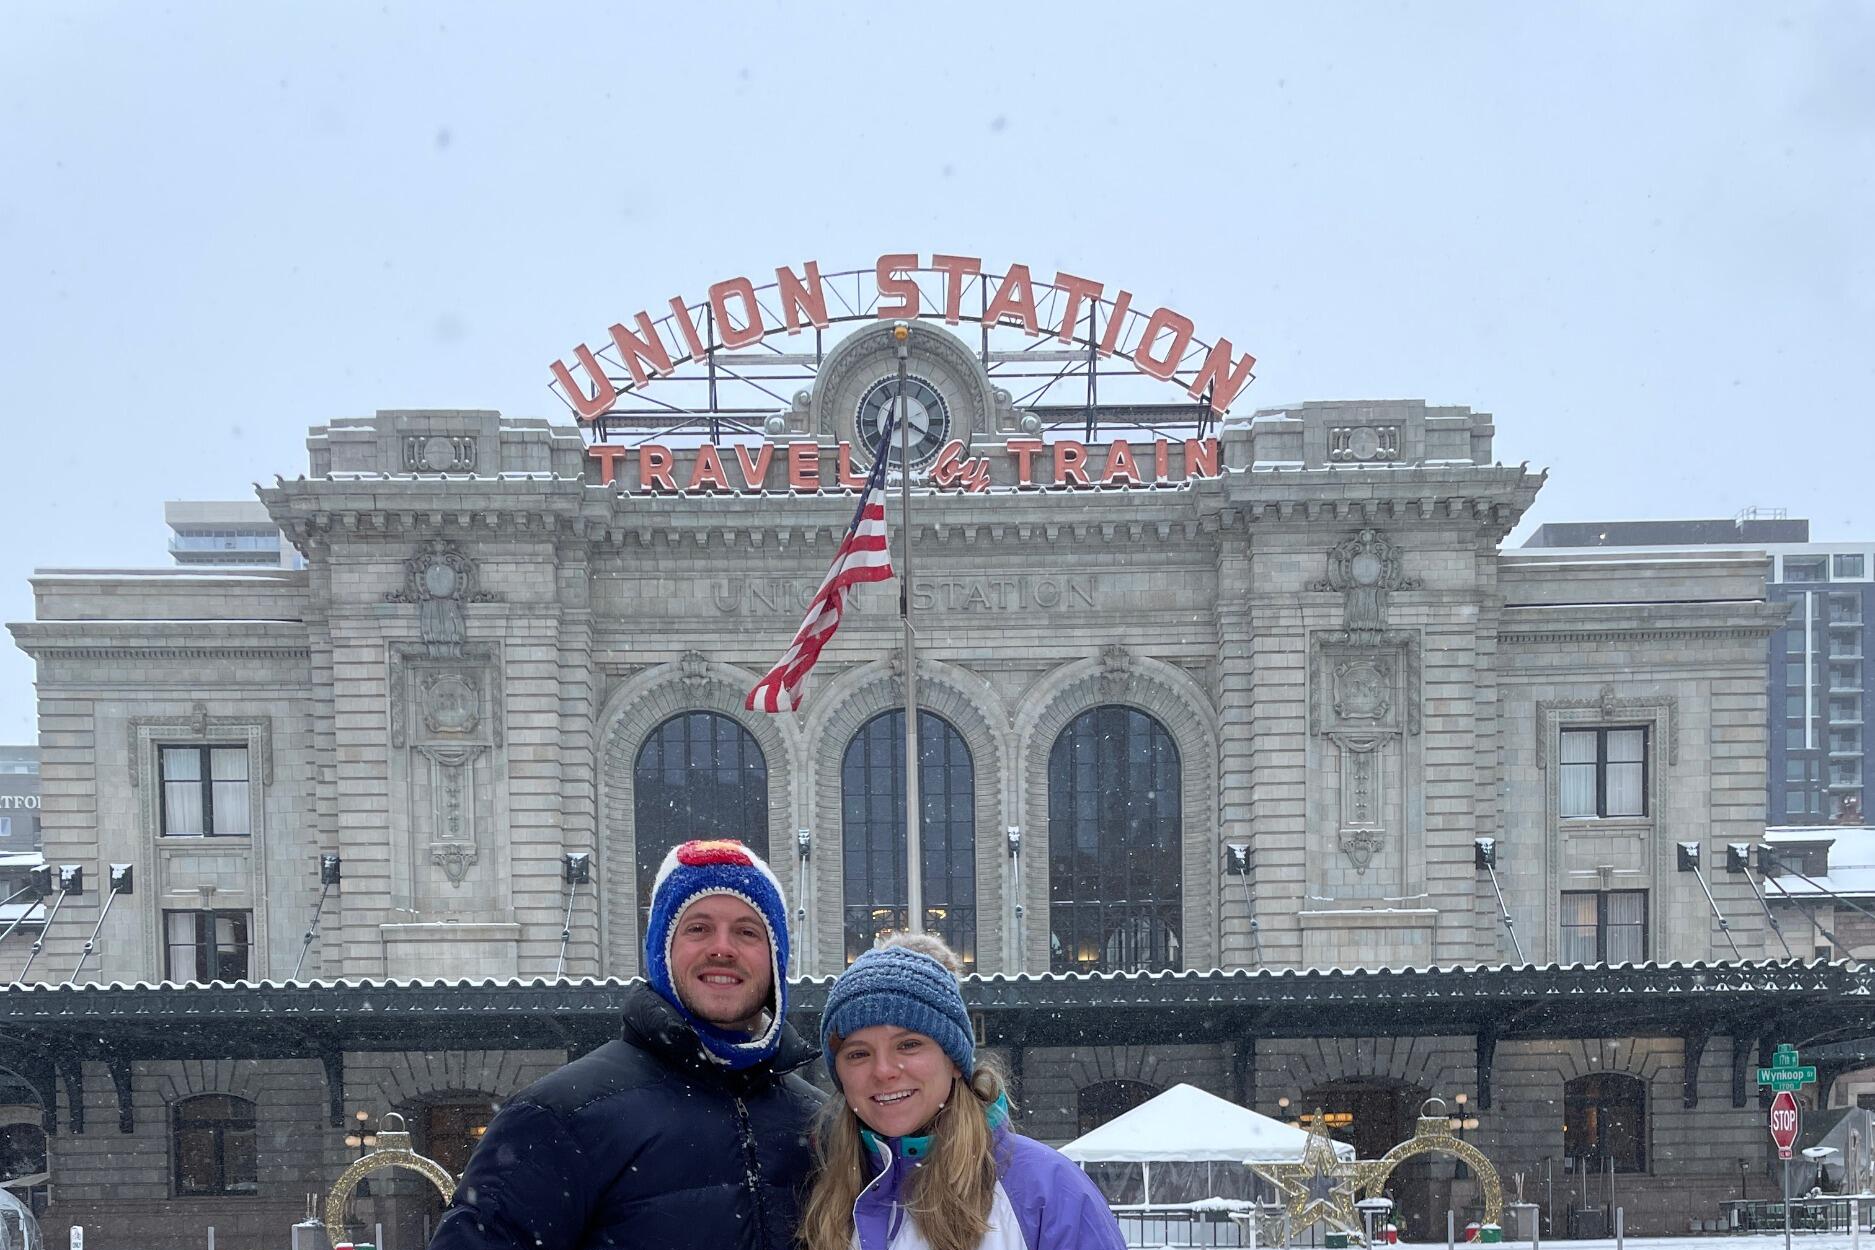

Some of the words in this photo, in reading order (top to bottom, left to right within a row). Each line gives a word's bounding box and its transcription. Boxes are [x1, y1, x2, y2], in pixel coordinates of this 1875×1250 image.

[549, 260, 829, 420] UNION
[875, 253, 1257, 415] STATION
[588, 441, 868, 491] TRAVEL
[929, 438, 991, 492] by
[1007, 437, 1218, 487] TRAIN
[912, 576, 1097, 610] STATION
[0, 795, 41, 809] TFO
[1761, 1070, 1804, 1082] Wynkoop
[1773, 1110, 1795, 1131] STOP
